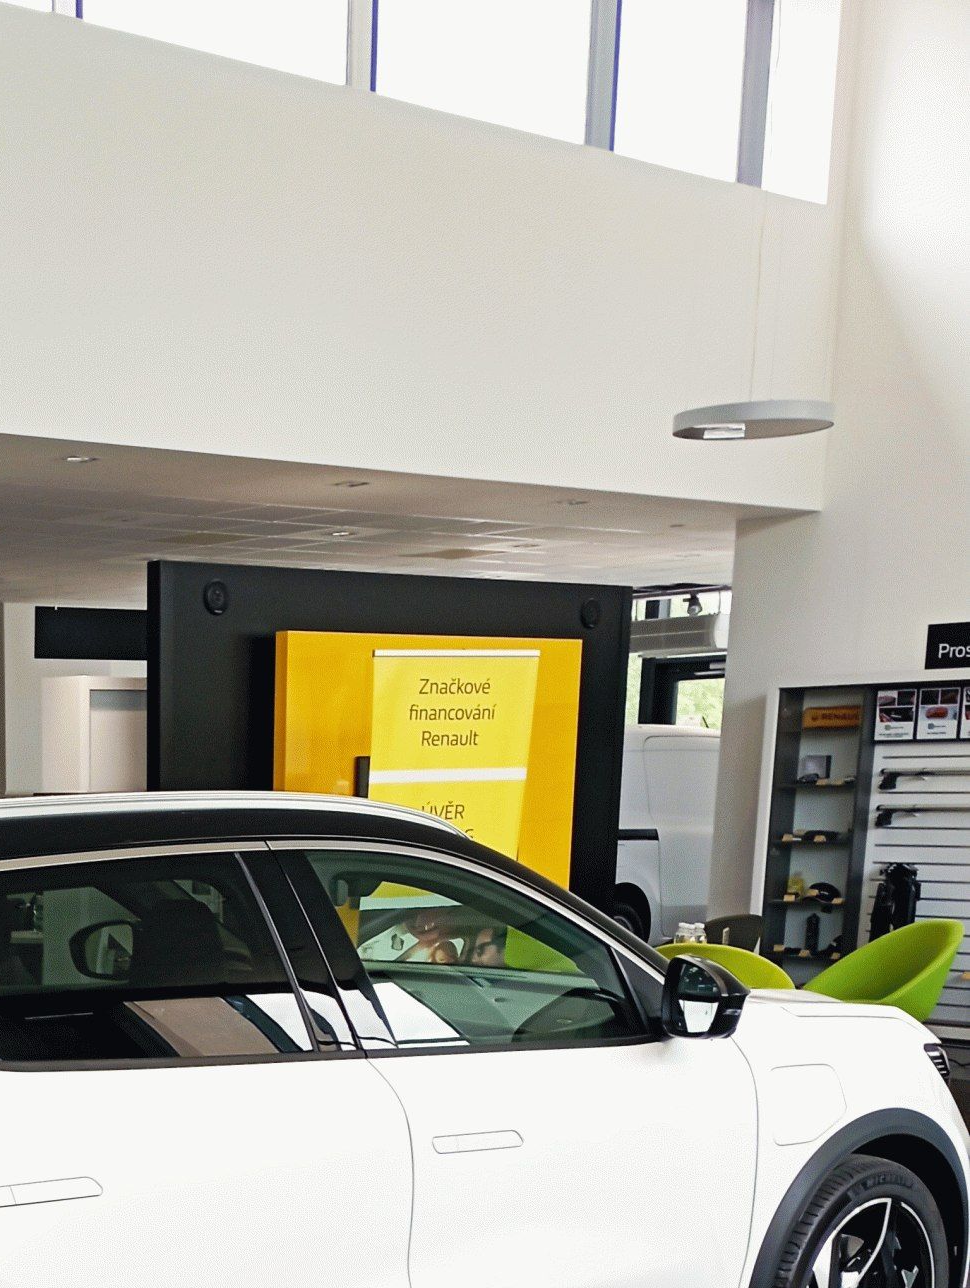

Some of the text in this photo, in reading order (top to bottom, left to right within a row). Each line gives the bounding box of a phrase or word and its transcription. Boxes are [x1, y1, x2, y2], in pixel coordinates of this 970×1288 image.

[418, 678, 491, 695] Značkové
[409, 703, 497, 721] financování
[421, 729, 479, 747] Renault
